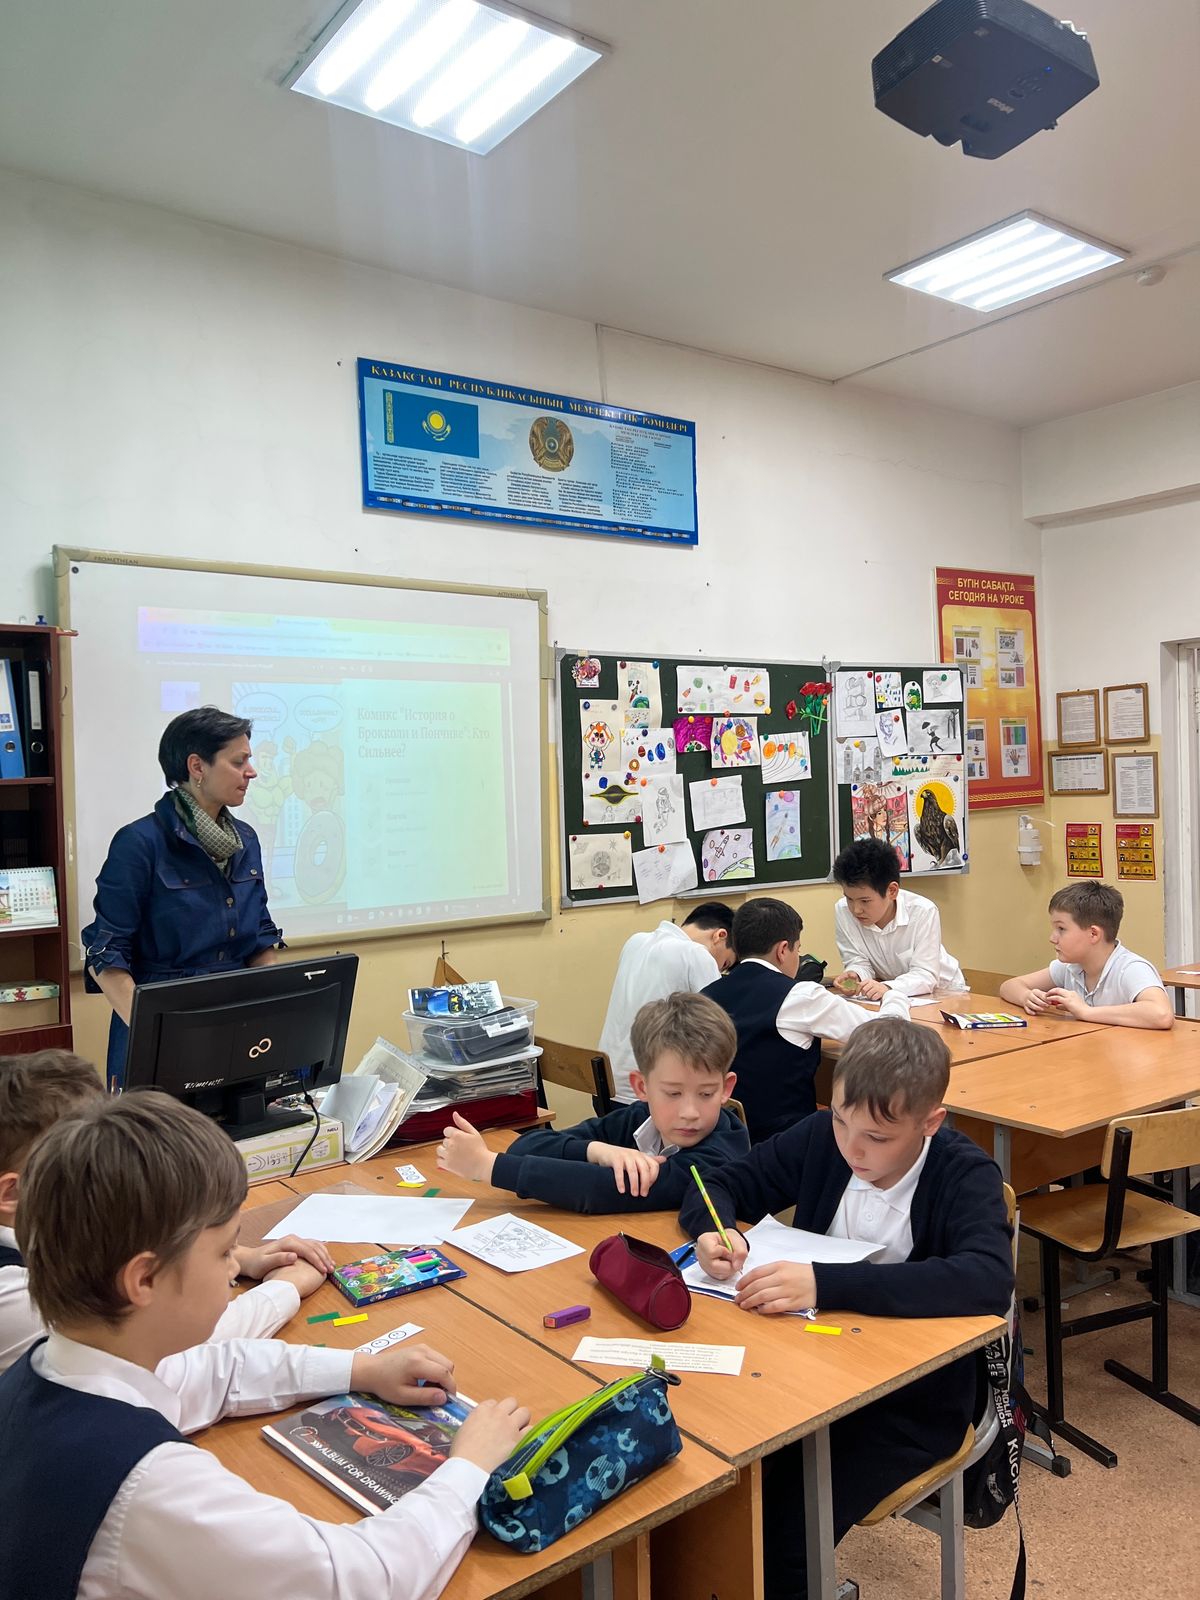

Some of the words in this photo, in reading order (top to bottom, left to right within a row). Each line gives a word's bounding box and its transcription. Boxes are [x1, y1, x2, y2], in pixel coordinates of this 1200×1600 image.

[370, 365, 443, 387] ҚАЗАҚСТАН
[957, 577, 980, 589] БҮГІН
[981, 579, 1016, 593] САБАҚТА
[948, 590, 986, 603] СЕГОДНЯ
[987, 593, 999, 604] НА
[1000, 594, 1025, 605] УРОКЕ
[357, 708, 398, 721] Комикс
[449, 712, 455, 721] о
[357, 726, 409, 742] Брокколи
[411, 729, 419, 740] и
[472, 728, 490, 740] Кто
[357, 744, 406, 758] Сильнее?
[319, 1446, 348, 1467] ALBUM
[344, 1463, 364, 1479] FOR
[360, 1477, 400, 1506] DRAWING
